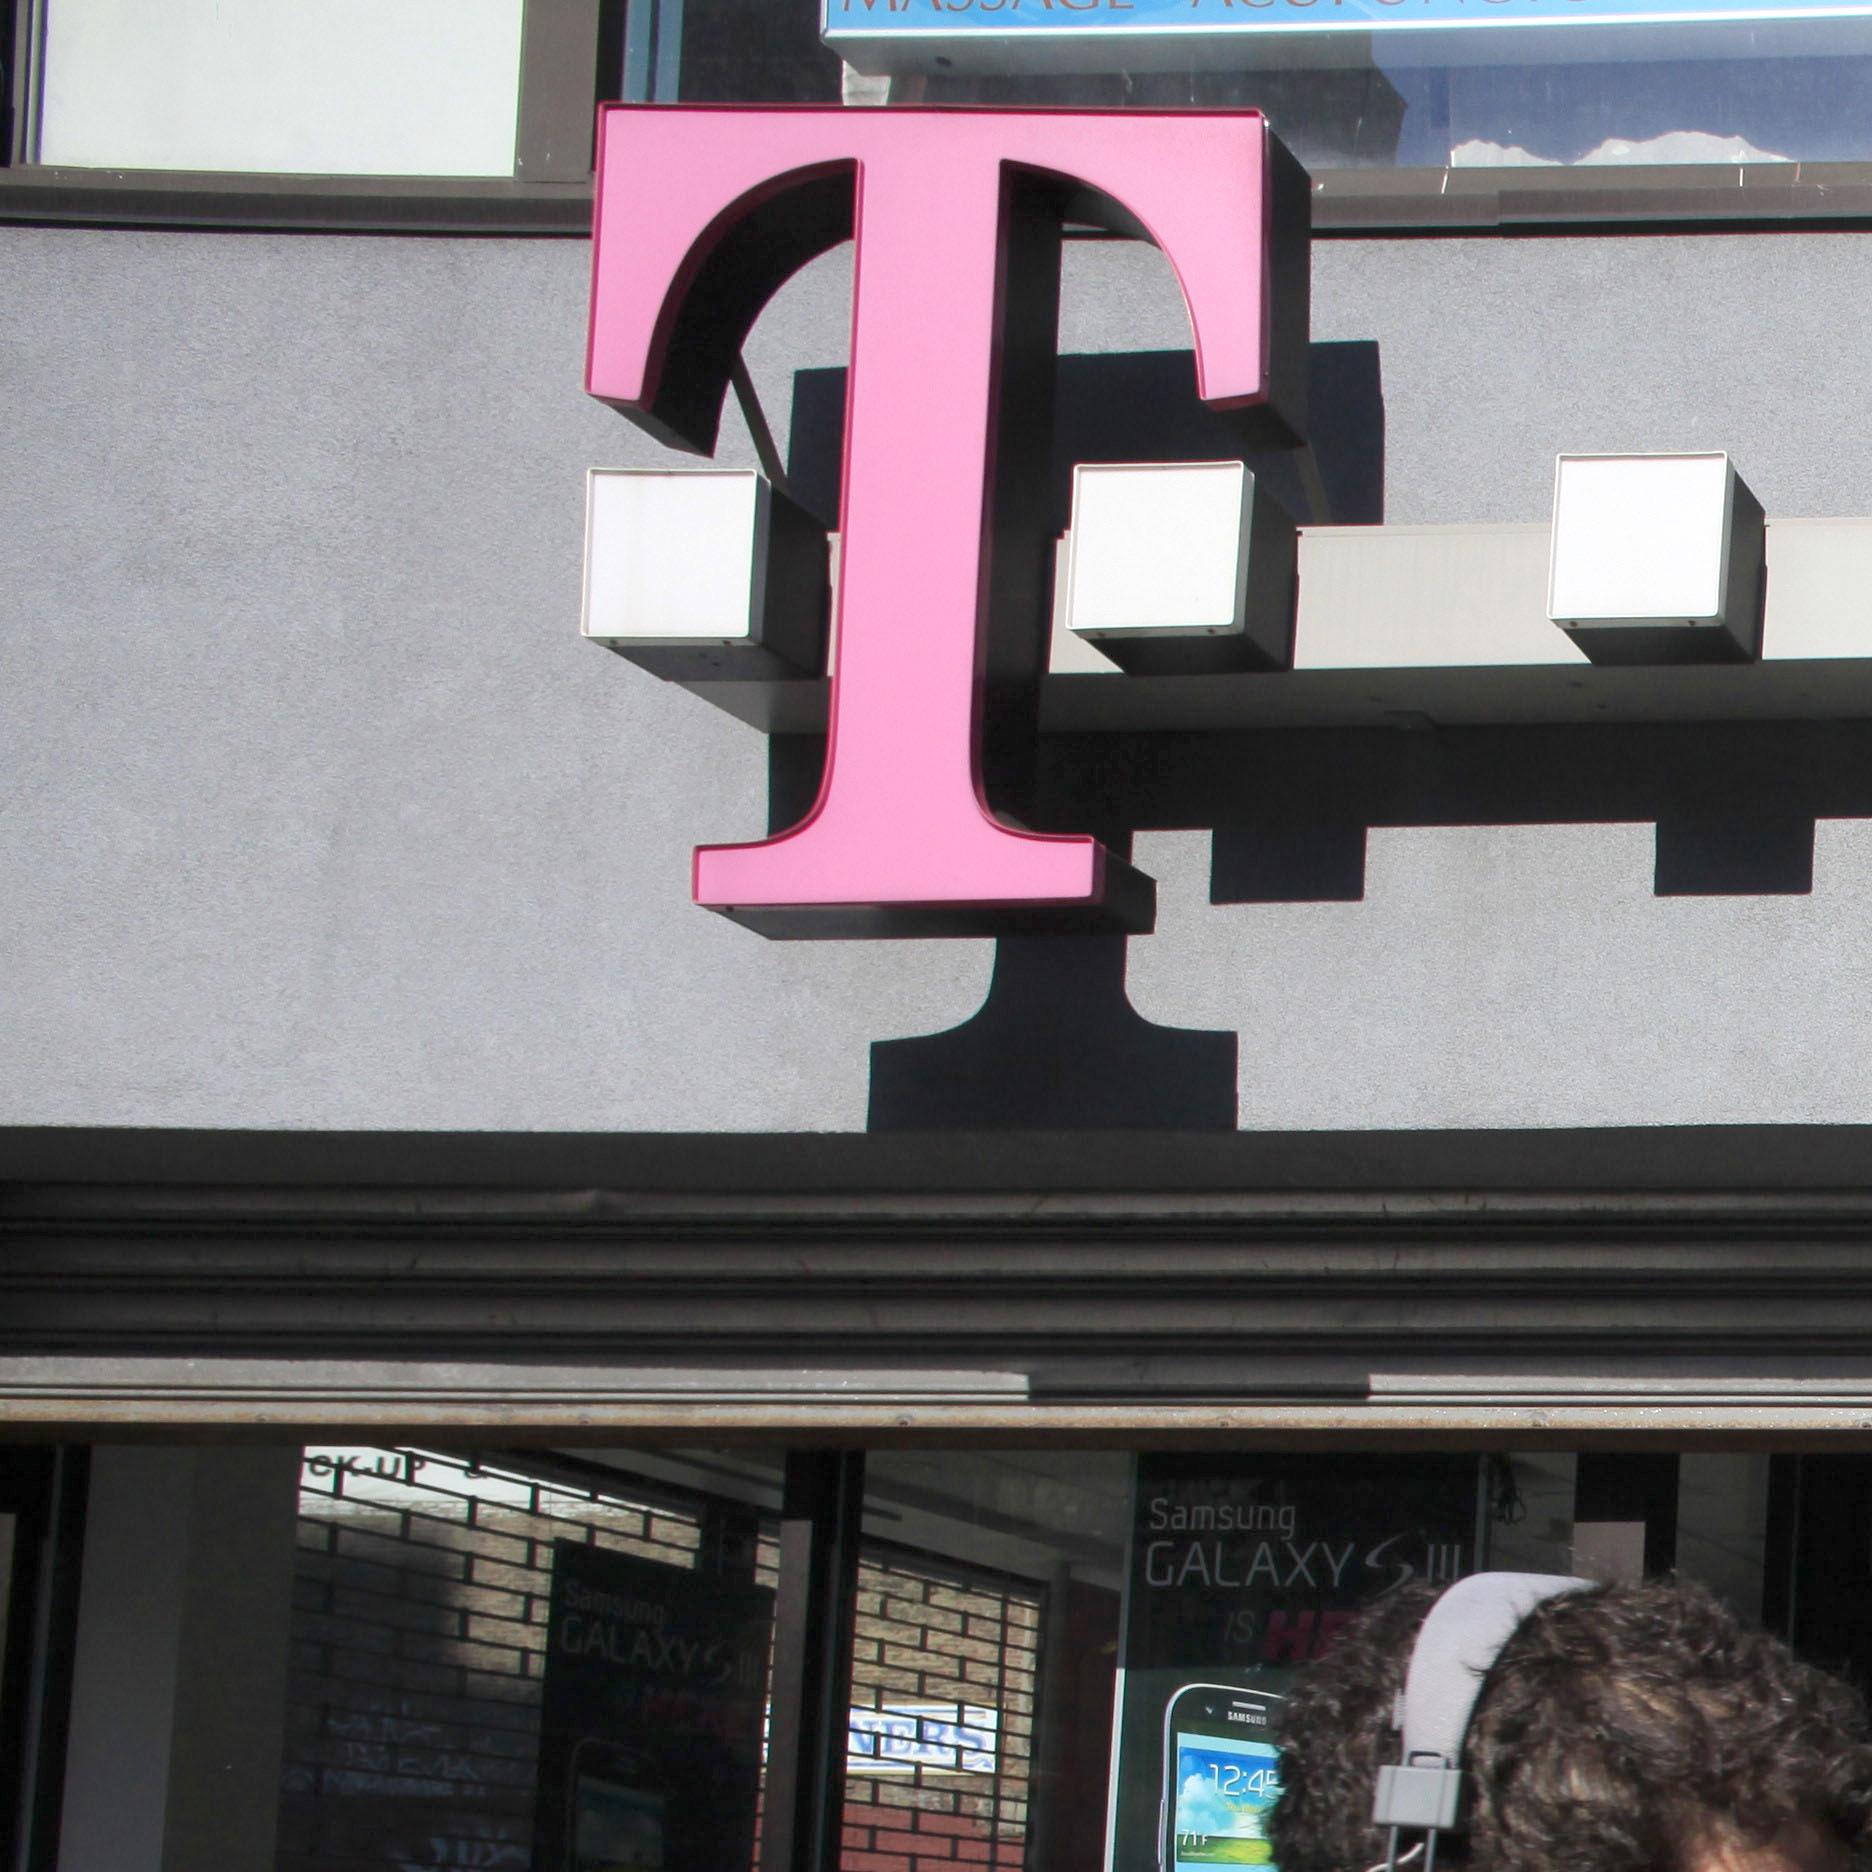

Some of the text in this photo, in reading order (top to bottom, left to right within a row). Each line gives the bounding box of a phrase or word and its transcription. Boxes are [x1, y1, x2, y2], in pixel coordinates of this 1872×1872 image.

[1150, 1497, 1297, 1541] Samsung
[1145, 1540, 1355, 1588] GALAXY
[849, 1719, 988, 1757] VERS
